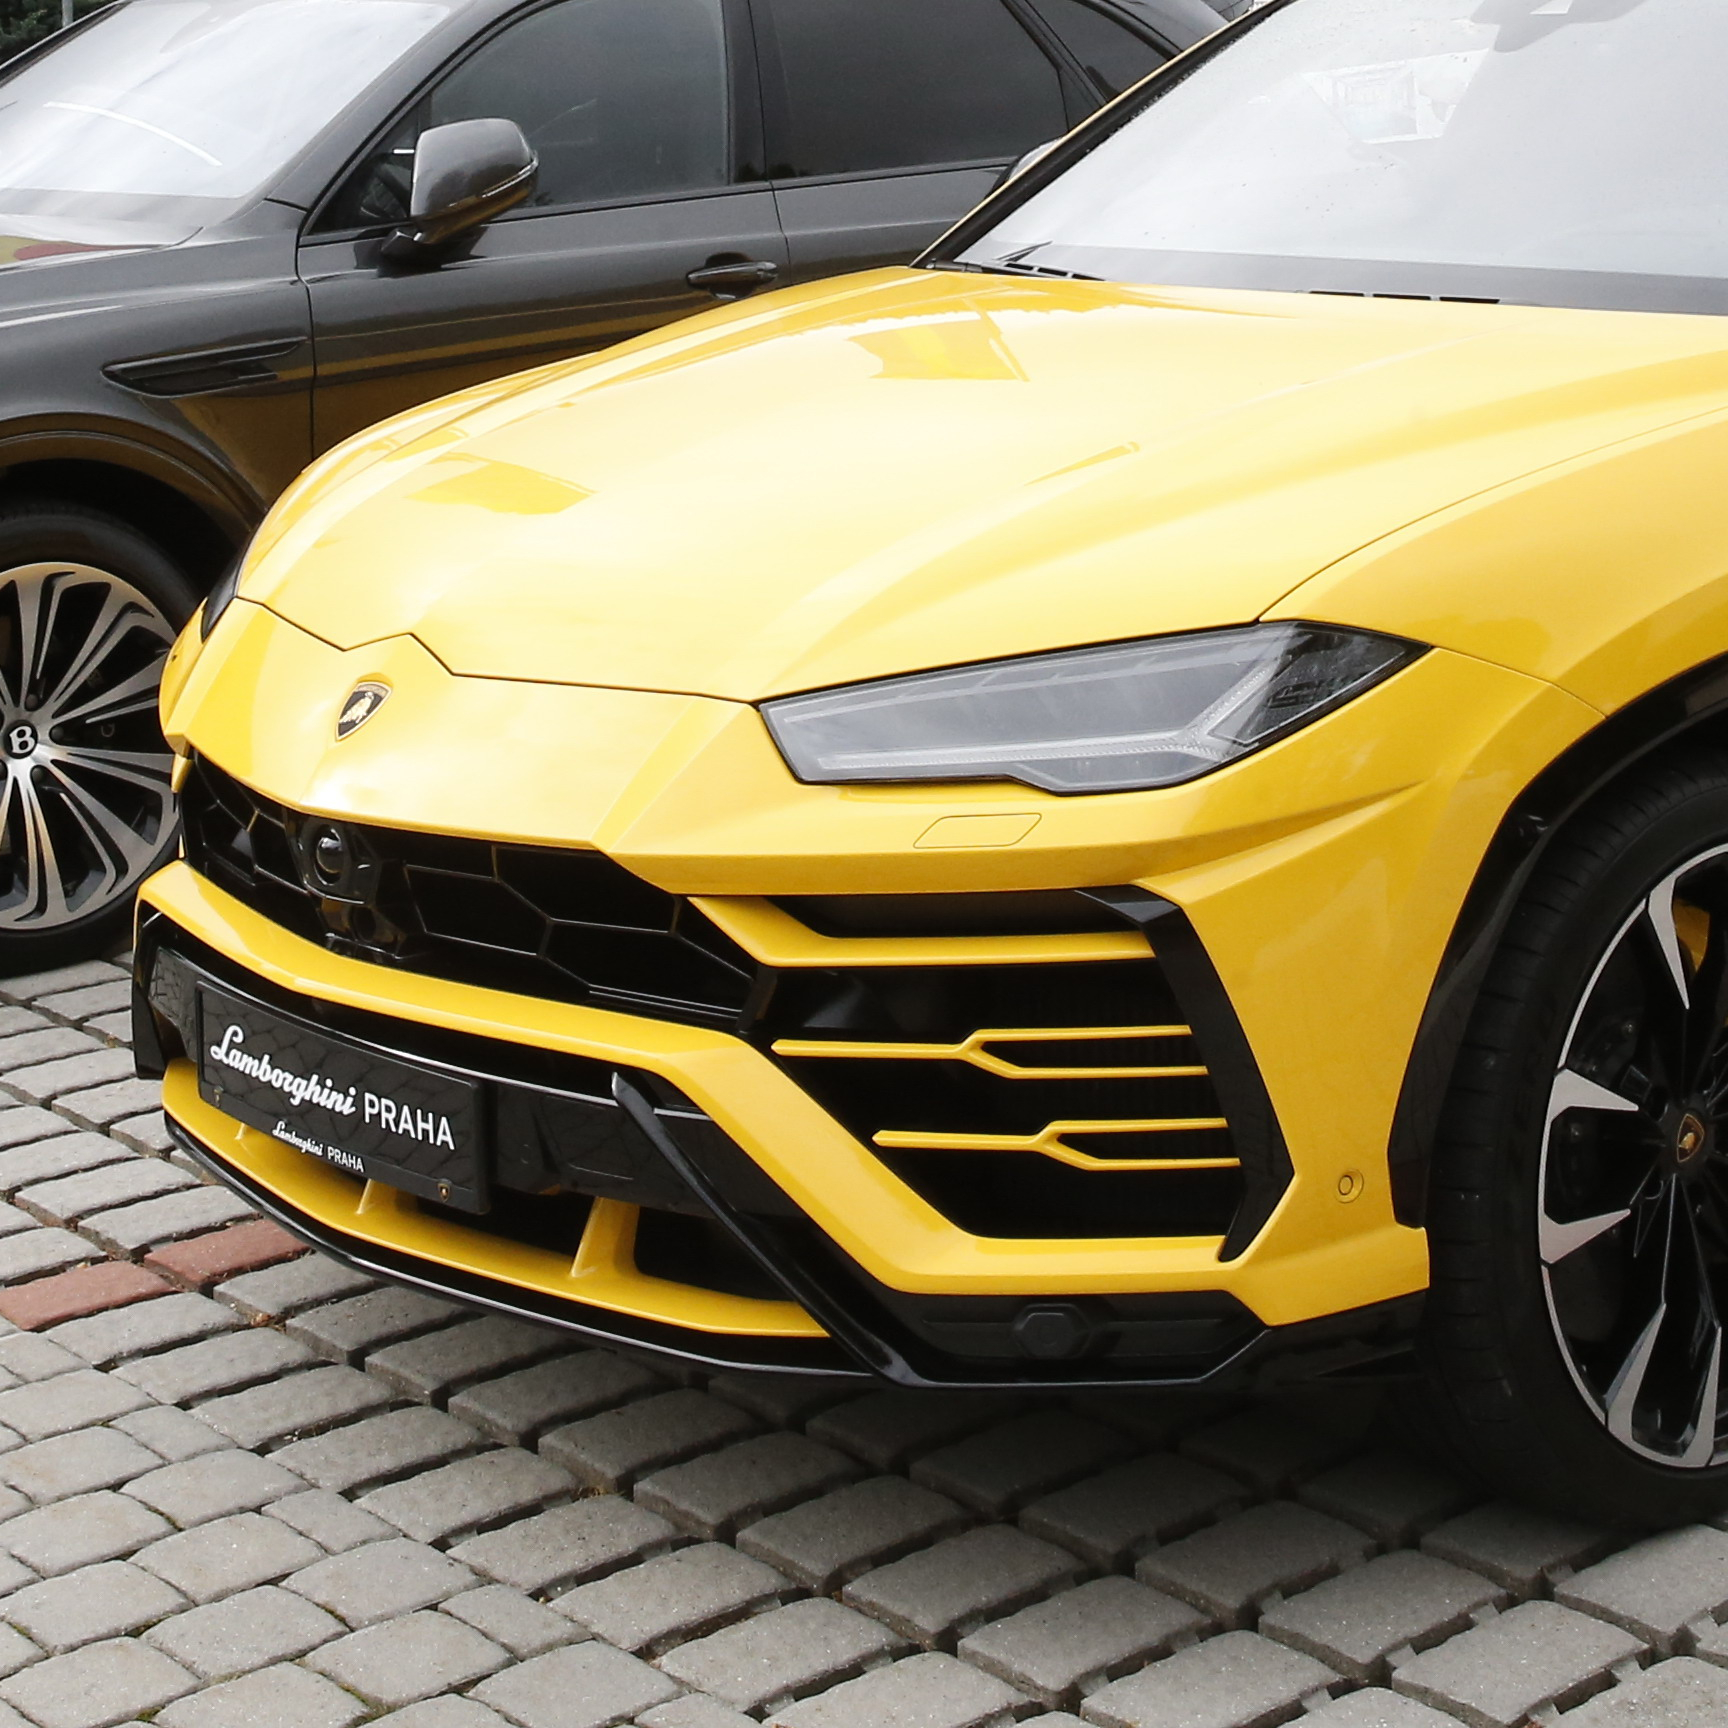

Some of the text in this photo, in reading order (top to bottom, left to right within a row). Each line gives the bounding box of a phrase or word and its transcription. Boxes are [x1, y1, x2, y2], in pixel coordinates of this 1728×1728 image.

[9, 725, 35, 753] B
[210, 1025, 456, 1151] Lamborghini PRAHA
[272, 1120, 365, 1173] Lamborghini PRAHA
